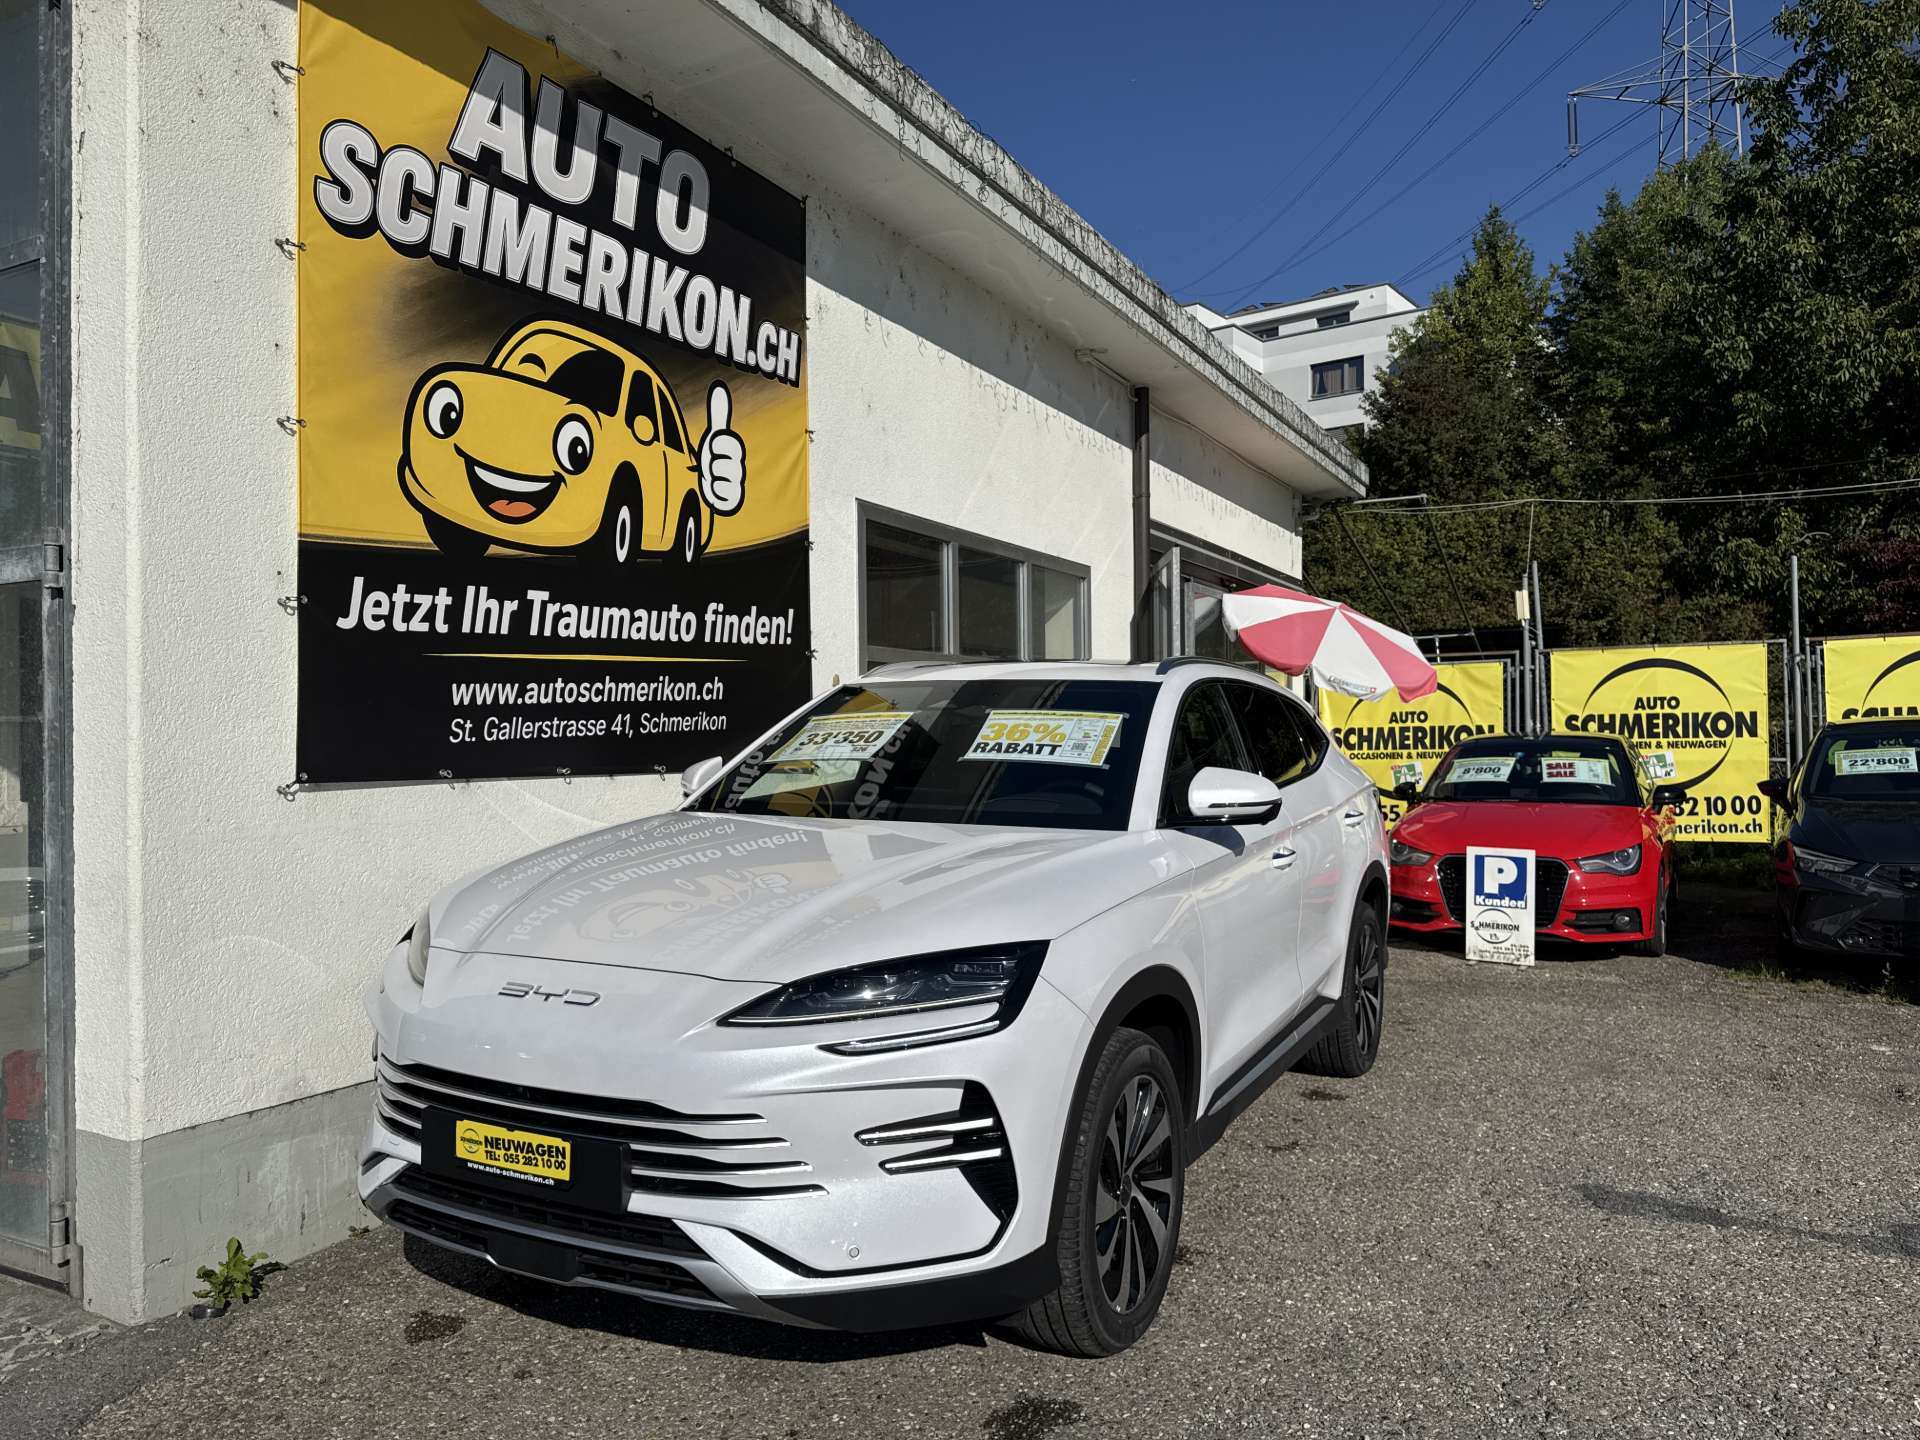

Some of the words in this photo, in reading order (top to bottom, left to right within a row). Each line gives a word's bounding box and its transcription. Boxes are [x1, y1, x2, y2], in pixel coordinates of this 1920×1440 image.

[447, 46, 711, 255] AUTO
[315, 121, 801, 381] SCHMERIKON.CH
[336, 575, 452, 633] Jetzt
[461, 585, 519, 635] Ihr
[525, 589, 697, 642] Traumauto
[702, 602, 794, 645] finden!
[451, 675, 724, 706] www.autoschmerikon.ch
[1633, 696, 1680, 711] AUTO
[449, 716, 477, 743] St.
[483, 713, 607, 742] Gallerstrasse
[610, 714, 635, 739] 41,
[639, 712, 728, 736] Schmerikon
[1388, 711, 1429, 724] AUTO
[1564, 711, 1758, 740] SCHMERIKON
[800, 730, 884, 746] 33'350
[979, 722, 1067, 743] 36%
[972, 742, 1062, 756] RABATT
[1349, 751, 1403, 760] OCCASIONEN
[1405, 751, 1413, 760] &
[1654, 741, 1663, 750] &
[1667, 739, 1727, 750] NEUWAGEN
[1848, 757, 1911, 767] 22'800
[1704, 796, 1727, 816] 10
[1730, 794, 1762, 816] 00
[1483, 856, 1518, 895] P
[1474, 894, 1526, 909] Kunden
[498, 981, 601, 1007] BYD
[483, 1135, 567, 1160] NEUWAGEN
[484, 1150, 501, 1162] TEL:
[503, 1152, 520, 1165] 055
[521, 1155, 539, 1168] 282
[541, 1157, 553, 1169] 10
[554, 1159, 567, 1171] 00
[467, 1161, 555, 1186] www.auto-schmerikon.ch
